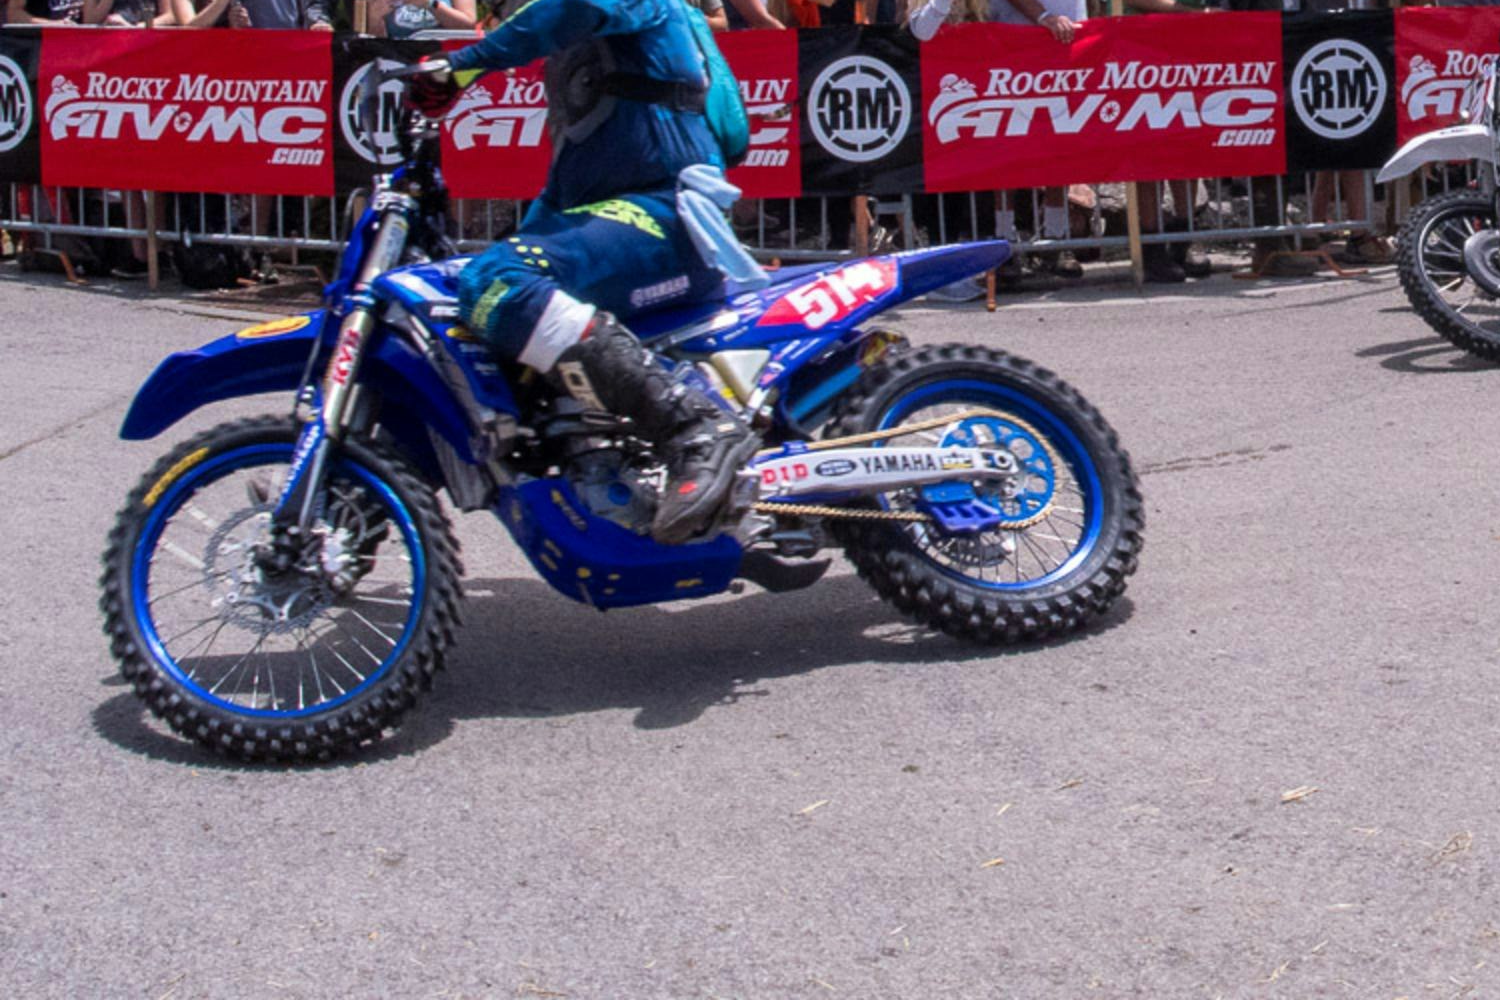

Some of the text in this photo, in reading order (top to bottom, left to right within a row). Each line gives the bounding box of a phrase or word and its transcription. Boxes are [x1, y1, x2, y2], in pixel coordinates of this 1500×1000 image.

[84, 72, 328, 103] ROCKY MOUNTAIN
[983, 61, 1276, 97] ROCKY MOUNTAIN
[1311, 69, 1366, 110] RM
[829, 87, 890, 130] RM
[1211, 128, 1276, 147] .com
[266, 147, 325, 166] .com
[784, 261, 885, 329] 514
[859, 453, 937, 474] YAMAHA
